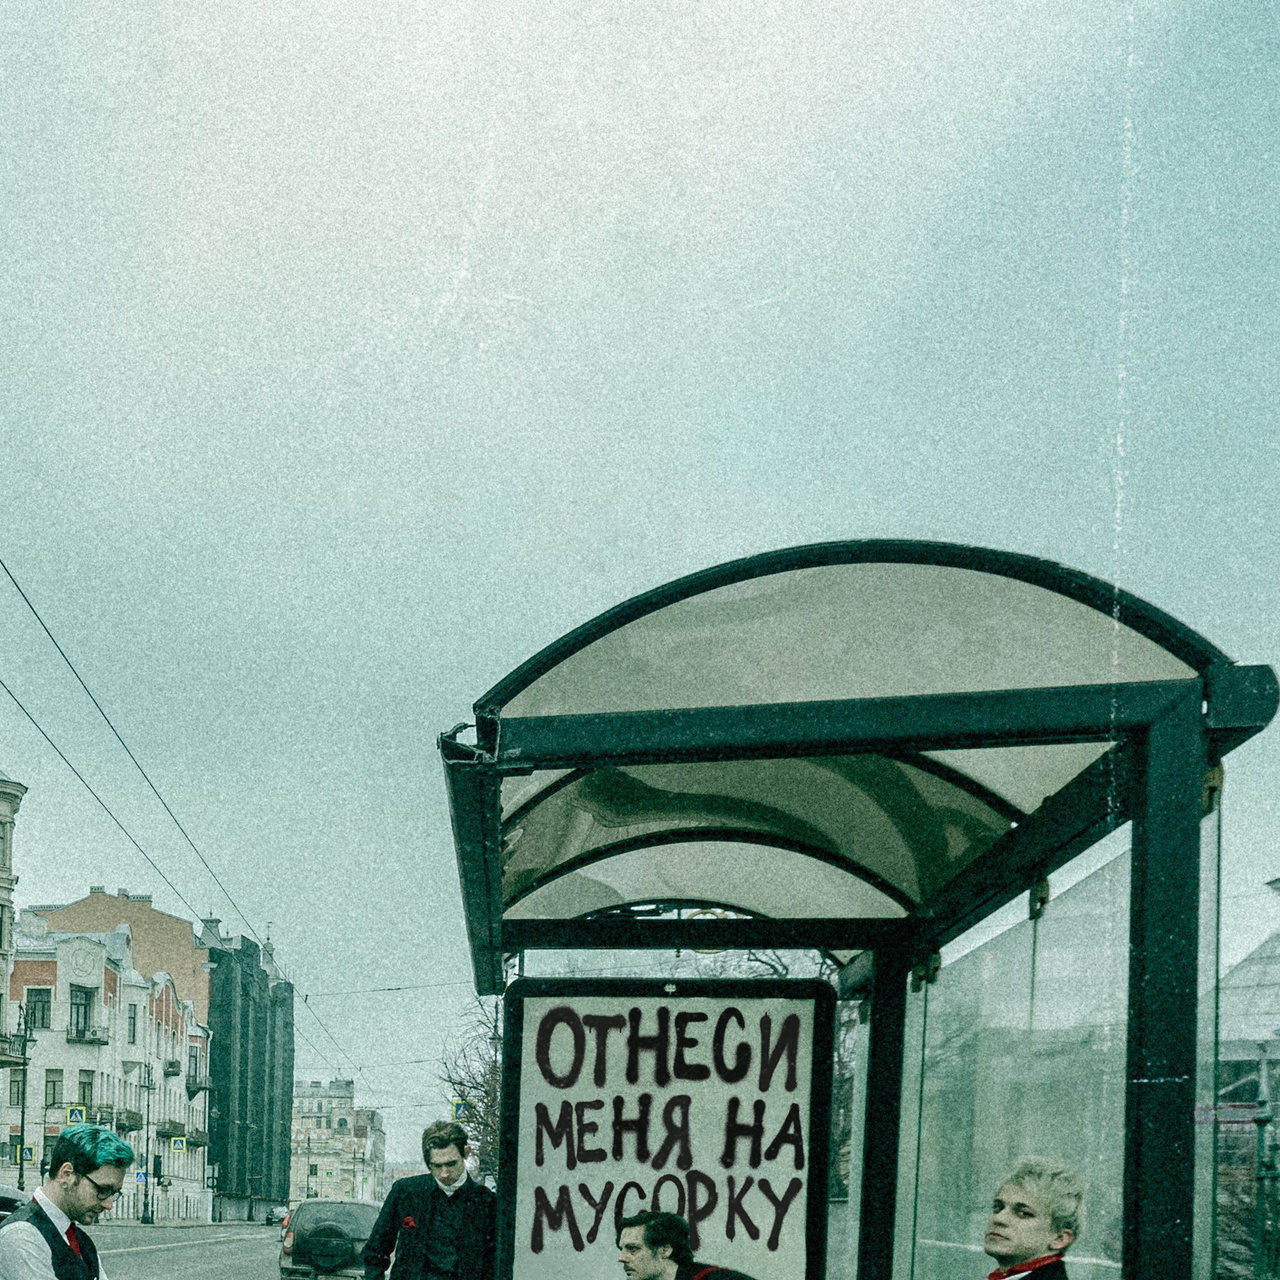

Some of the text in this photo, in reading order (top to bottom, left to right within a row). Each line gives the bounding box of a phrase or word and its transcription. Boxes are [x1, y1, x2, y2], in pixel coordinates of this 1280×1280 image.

[535, 1006, 801, 1092] ОТНЕСИ
[534, 1093, 806, 1171] МЕНЯ НА
